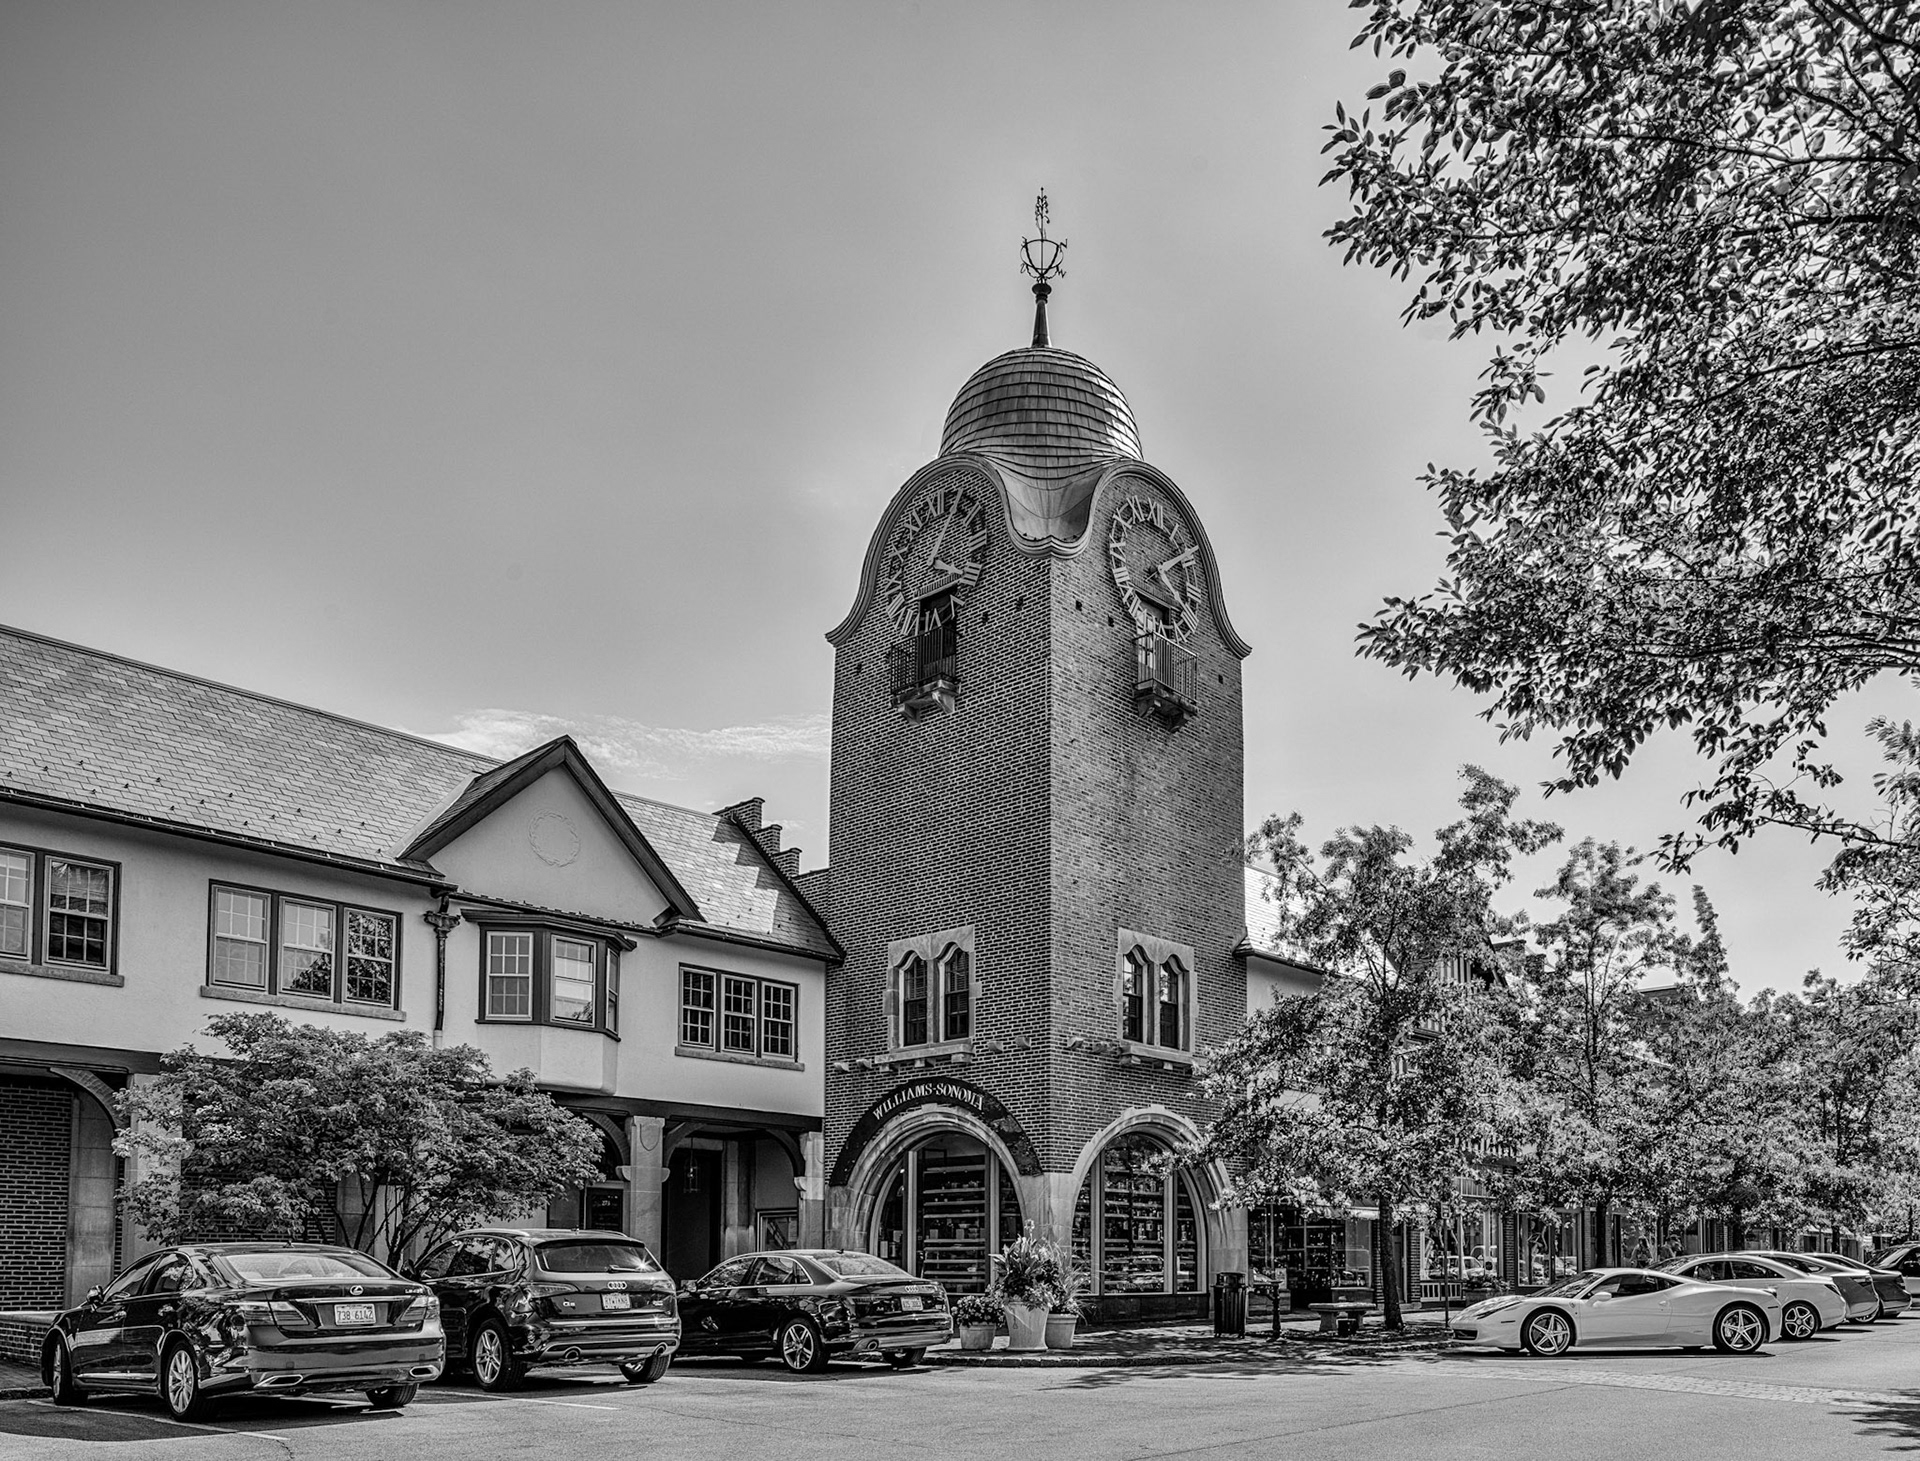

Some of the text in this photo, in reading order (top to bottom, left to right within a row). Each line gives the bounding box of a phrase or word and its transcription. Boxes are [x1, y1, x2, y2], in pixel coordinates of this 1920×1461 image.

[1059, 238, 1068, 252] N
[904, 508, 924, 542] XI
[1112, 507, 1133, 539] X
[1126, 495, 1145, 525] XI
[1147, 496, 1164, 530] XII
[968, 528, 988, 552] III
[1186, 581, 1202, 604] III
[873, 1082, 984, 1120] WILLIAMS-SONOMA
